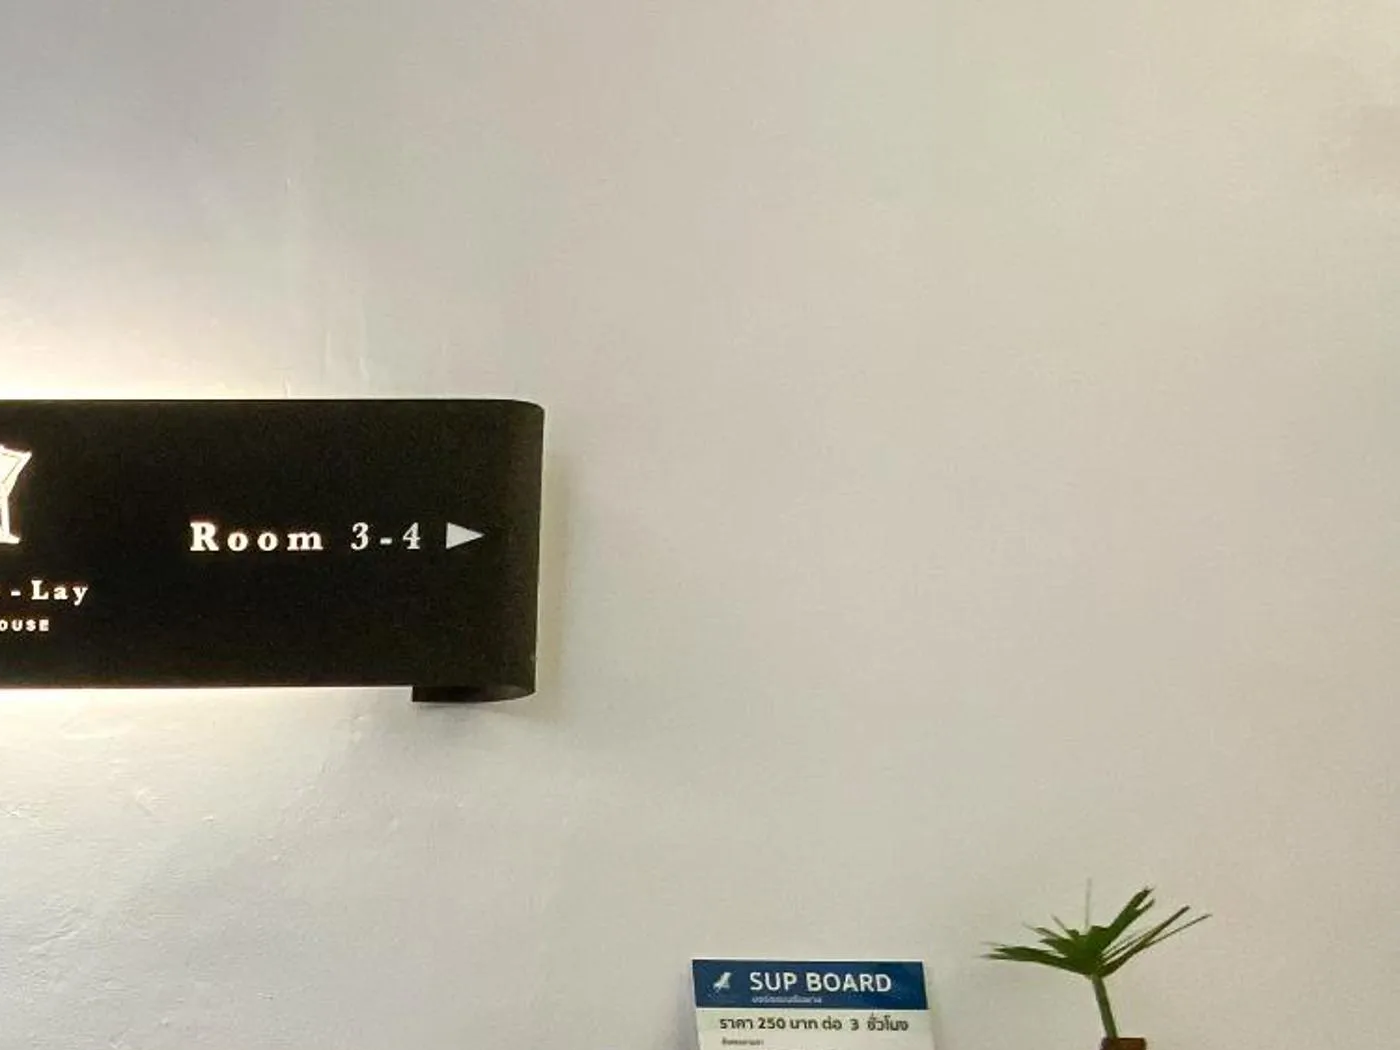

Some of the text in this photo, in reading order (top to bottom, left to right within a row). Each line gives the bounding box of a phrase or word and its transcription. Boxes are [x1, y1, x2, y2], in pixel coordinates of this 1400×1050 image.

[189, 521, 421, 552] Room 3-4
[749, 971, 892, 992] SUP BOARD
[719, 1017, 754, 1030] ราคา
[758, 1017, 786, 1030] 250
[850, 1018, 860, 1031] 3
